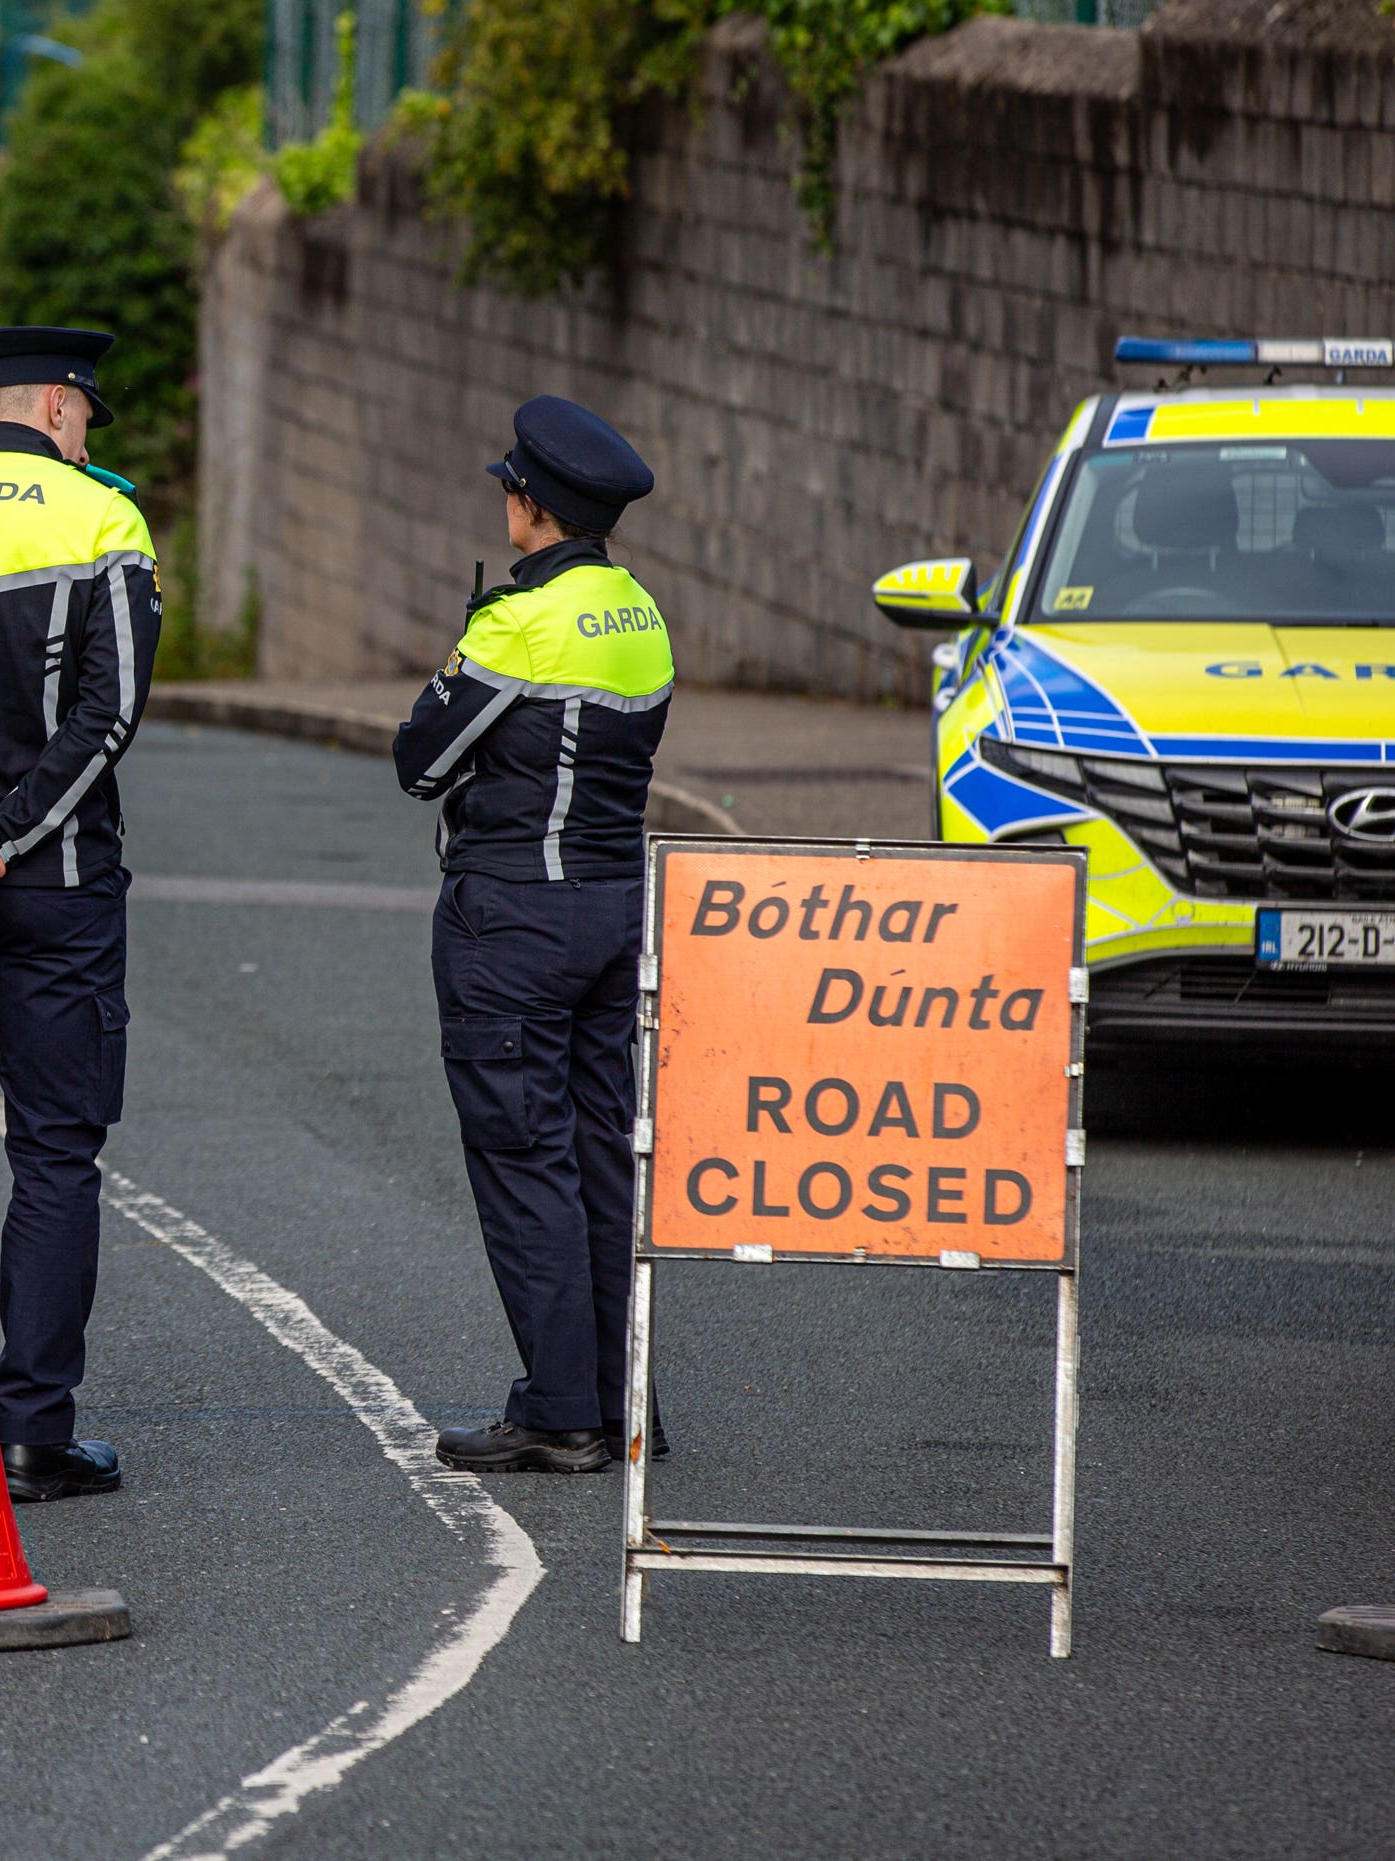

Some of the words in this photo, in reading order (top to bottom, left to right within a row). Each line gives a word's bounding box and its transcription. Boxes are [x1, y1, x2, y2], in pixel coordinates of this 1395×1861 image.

[1329, 347, 1388, 365] GARDA
[577, 606, 662, 638] GARDA
[690, 880, 958, 944] Bóthar
[807, 967, 1045, 1032] Dúnta
[746, 1075, 982, 1140] ROAD
[686, 1157, 1034, 1226] CLOSED
